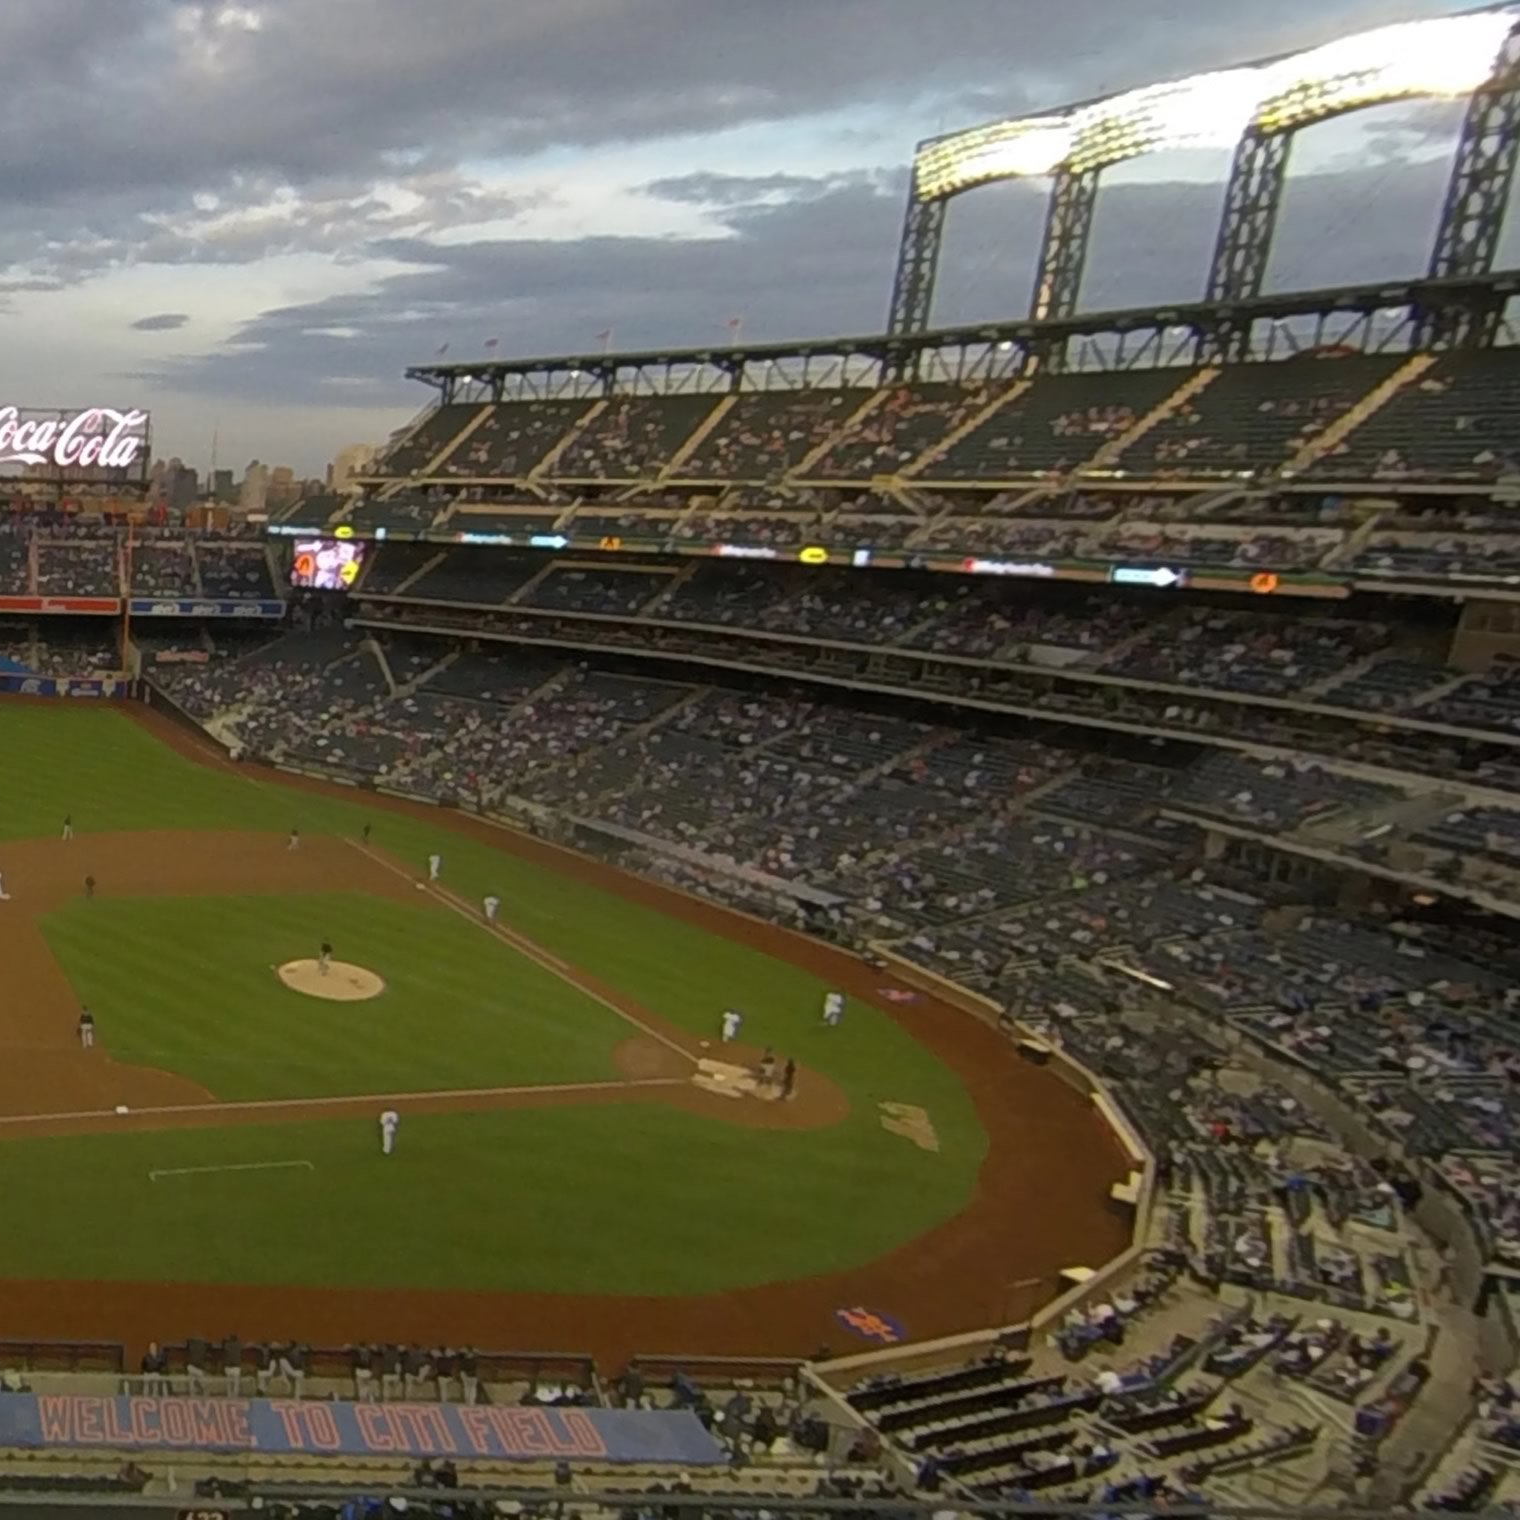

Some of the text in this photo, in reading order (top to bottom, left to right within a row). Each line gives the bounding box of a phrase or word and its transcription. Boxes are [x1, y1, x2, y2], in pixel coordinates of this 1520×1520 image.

[38, 1396, 608, 1457] WELCOME TO CITI FIELD
